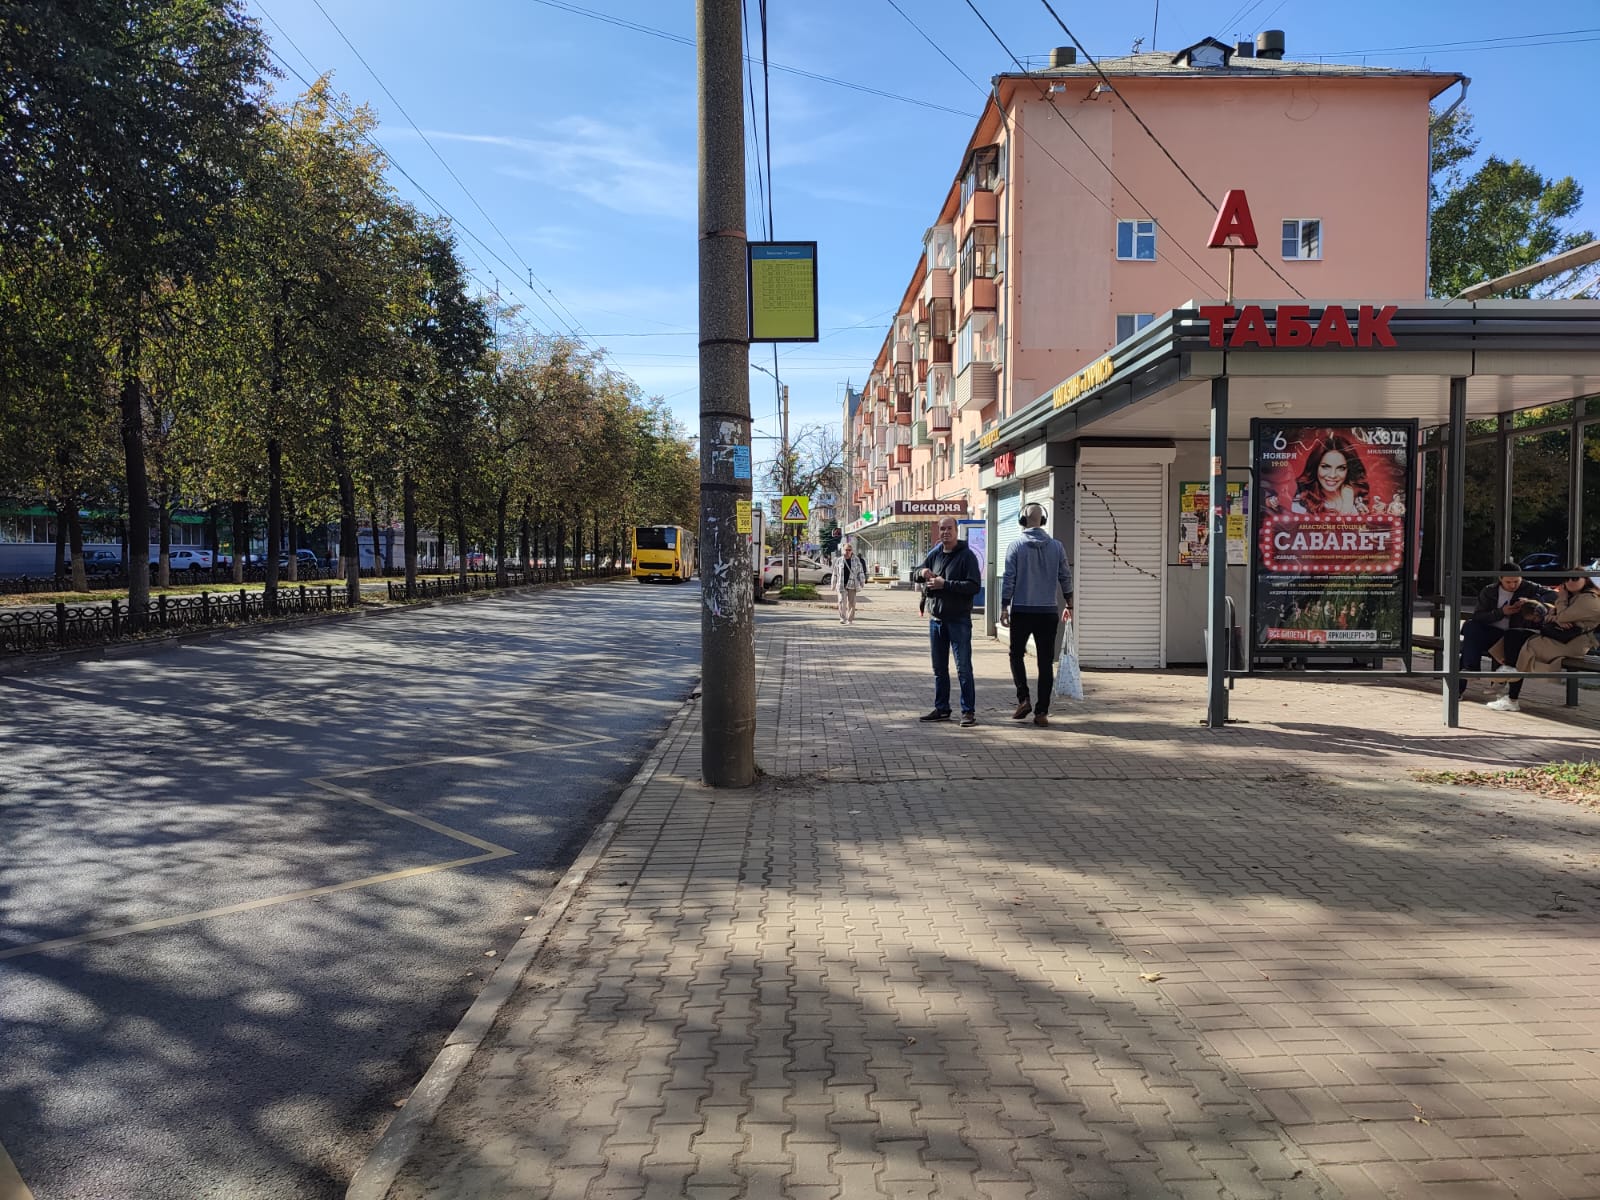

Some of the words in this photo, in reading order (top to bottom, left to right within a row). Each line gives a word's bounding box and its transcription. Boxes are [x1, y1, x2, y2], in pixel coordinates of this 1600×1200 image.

[1207, 190, 1258, 248] А
[1199, 305, 1398, 347] ТАБАК
[1273, 431, 1287, 450] 6
[1262, 452, 1298, 460] НОЯБРЯ
[902, 501, 961, 515] Пекарня
[1274, 532, 1390, 551] CABARET
[1281, 630, 1307, 640] БИЛЕТЫ
